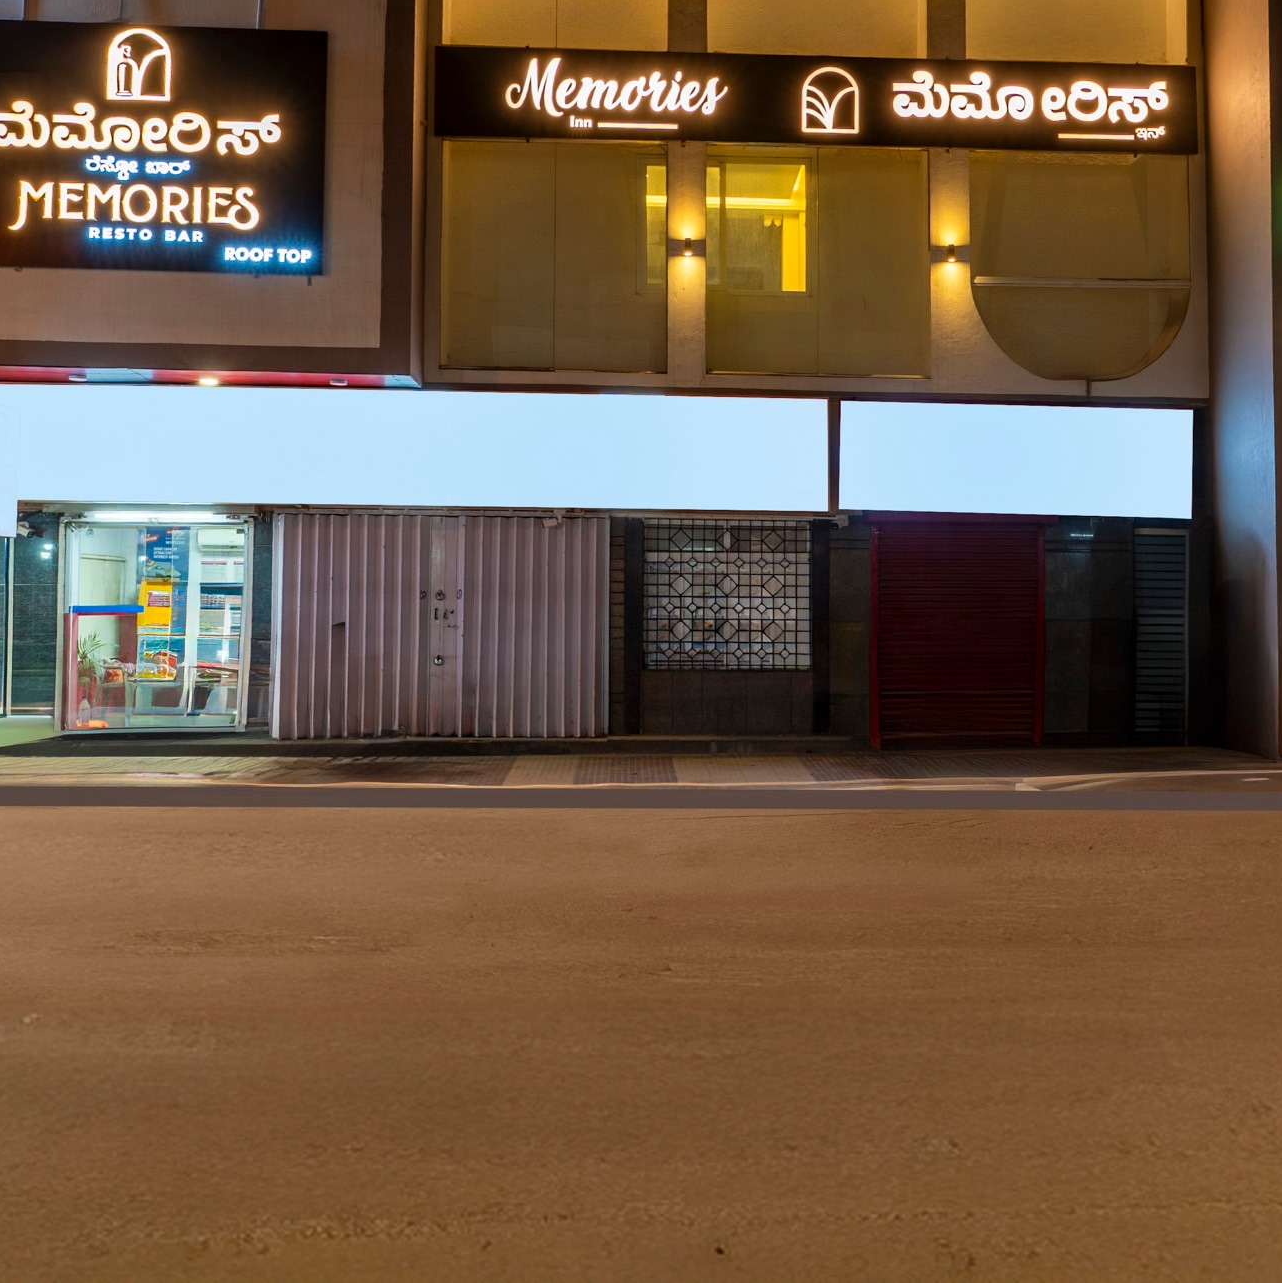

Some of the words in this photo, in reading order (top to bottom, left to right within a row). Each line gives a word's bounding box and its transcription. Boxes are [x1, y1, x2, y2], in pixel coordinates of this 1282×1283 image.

[505, 57, 728, 116] Memories
[892, 70, 1169, 124] ಮೆಮೋರಿಸ್
[570, 115, 592, 128] Inn
[1135, 125, 1166, 141] ಇನ್
[8, 180, 260, 231] MEMORIES
[88, 226, 153, 241] RESTO
[164, 229, 204, 243] BAR
[224, 246, 274, 262] ROOF
[277, 248, 312, 264] TOP
